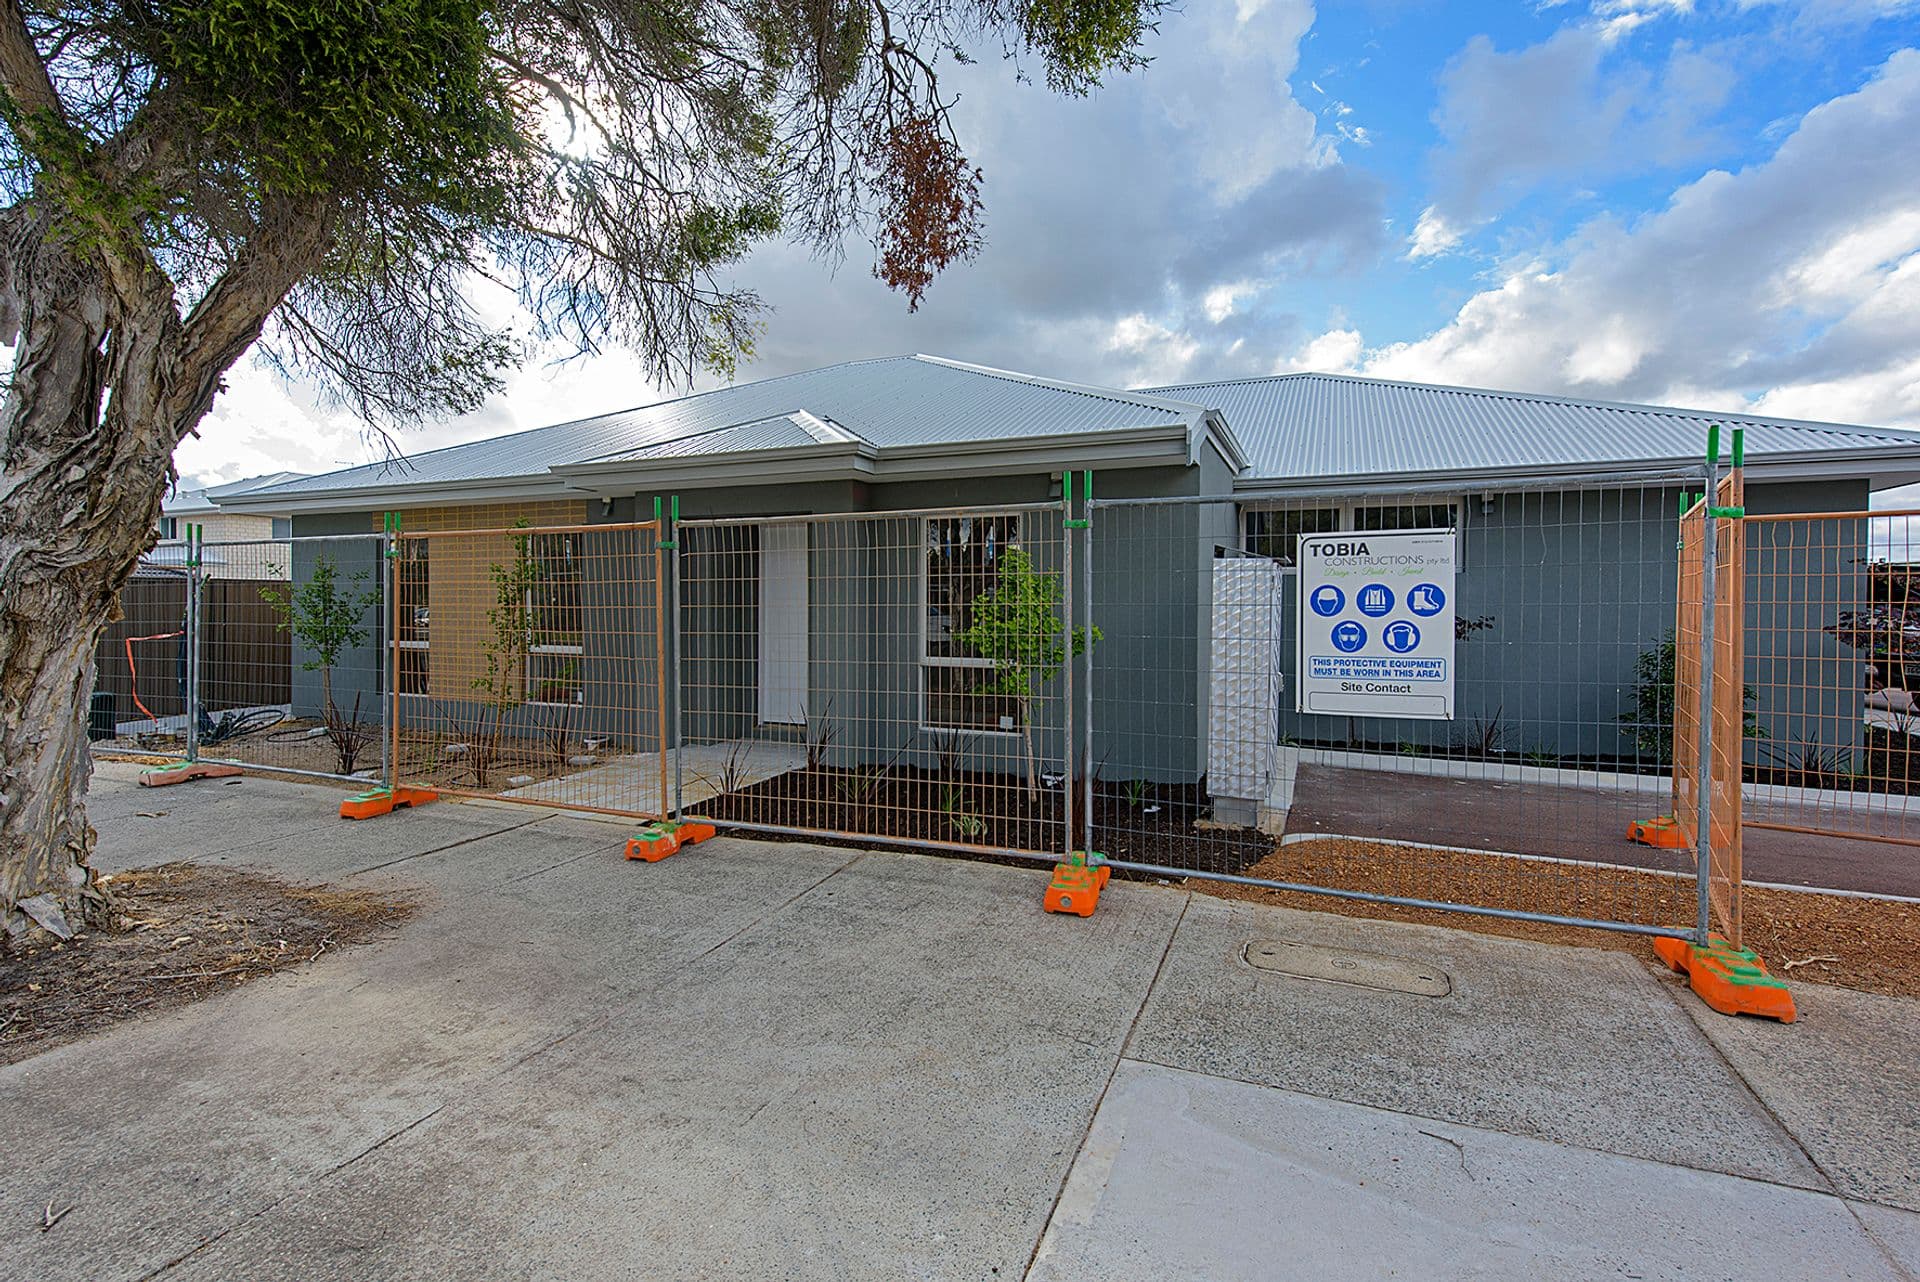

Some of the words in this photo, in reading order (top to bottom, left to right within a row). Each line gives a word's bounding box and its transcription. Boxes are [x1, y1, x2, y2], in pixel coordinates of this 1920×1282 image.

[1310, 542, 1370, 557] TOBIA
[1324, 555, 1424, 567] CONSTRUCTIONS
[1427, 558, 1438, 566] pty
[1312, 658, 1332, 667] THIS
[1333, 659, 1387, 668] PROTECTIVE
[1389, 660, 1443, 669] EQUIPMENT
[1313, 667, 1338, 676] MUST
[1340, 668, 1351, 676] BE
[1353, 668, 1380, 677] WORN
[1382, 669, 1391, 677] IN
[1394, 669, 1414, 678] THIS
[1416, 670, 1441, 678] AREA
[1340, 681, 1362, 692] Site
[1365, 682, 1412, 694] Contact
